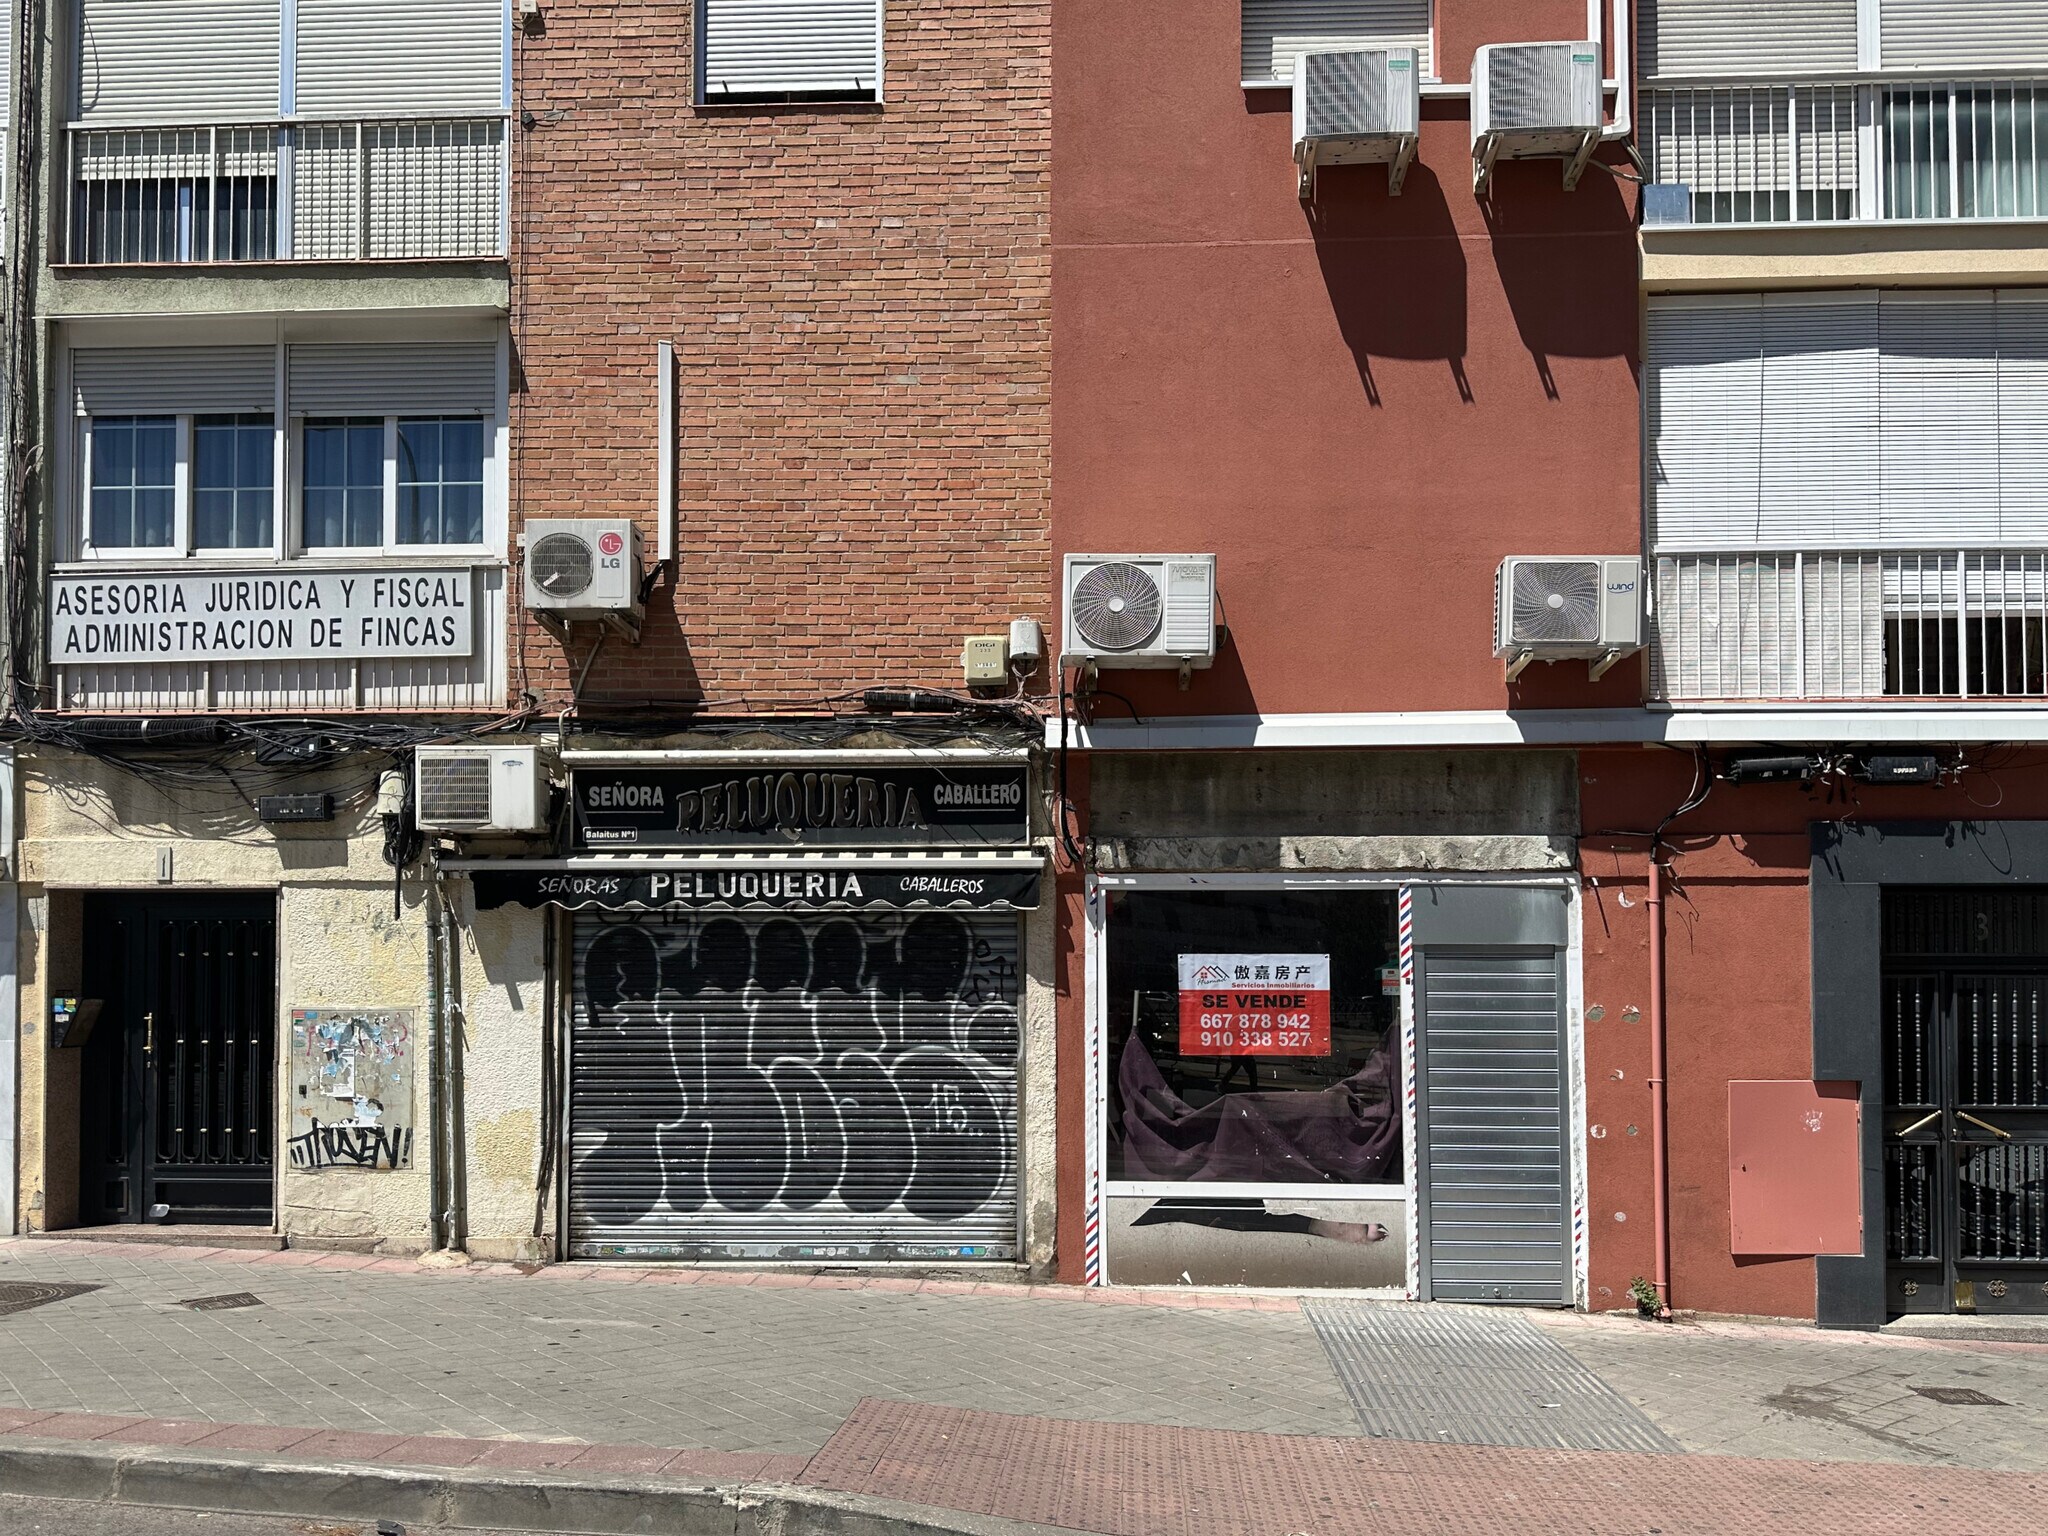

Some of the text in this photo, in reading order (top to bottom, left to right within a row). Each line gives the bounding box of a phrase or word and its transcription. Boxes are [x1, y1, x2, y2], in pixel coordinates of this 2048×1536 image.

[601, 558, 620, 568] LG
[56, 577, 464, 616] ASESORIA JURIDICA Y FISCAL
[65, 615, 455, 653] ADMINISTRACION DE FINCAS
[588, 781, 664, 807] SEÑORA
[934, 784, 1020, 805] CABALLERO
[676, 772, 928, 841] PELUQUERIA
[586, 830, 619, 838] Balaitus
[538, 874, 620, 894] SEÑORAS
[650, 872, 863, 900] PELUQUERIA
[900, 876, 984, 894] CABALLEROS
[1234, 965, 1311, 980] 傲嘉房产
[1202, 994, 1306, 1009] SE VENDE
[1200, 1013, 1310, 1029] 667 878 942
[1200, 1032, 1311, 1047] 910 338 527
